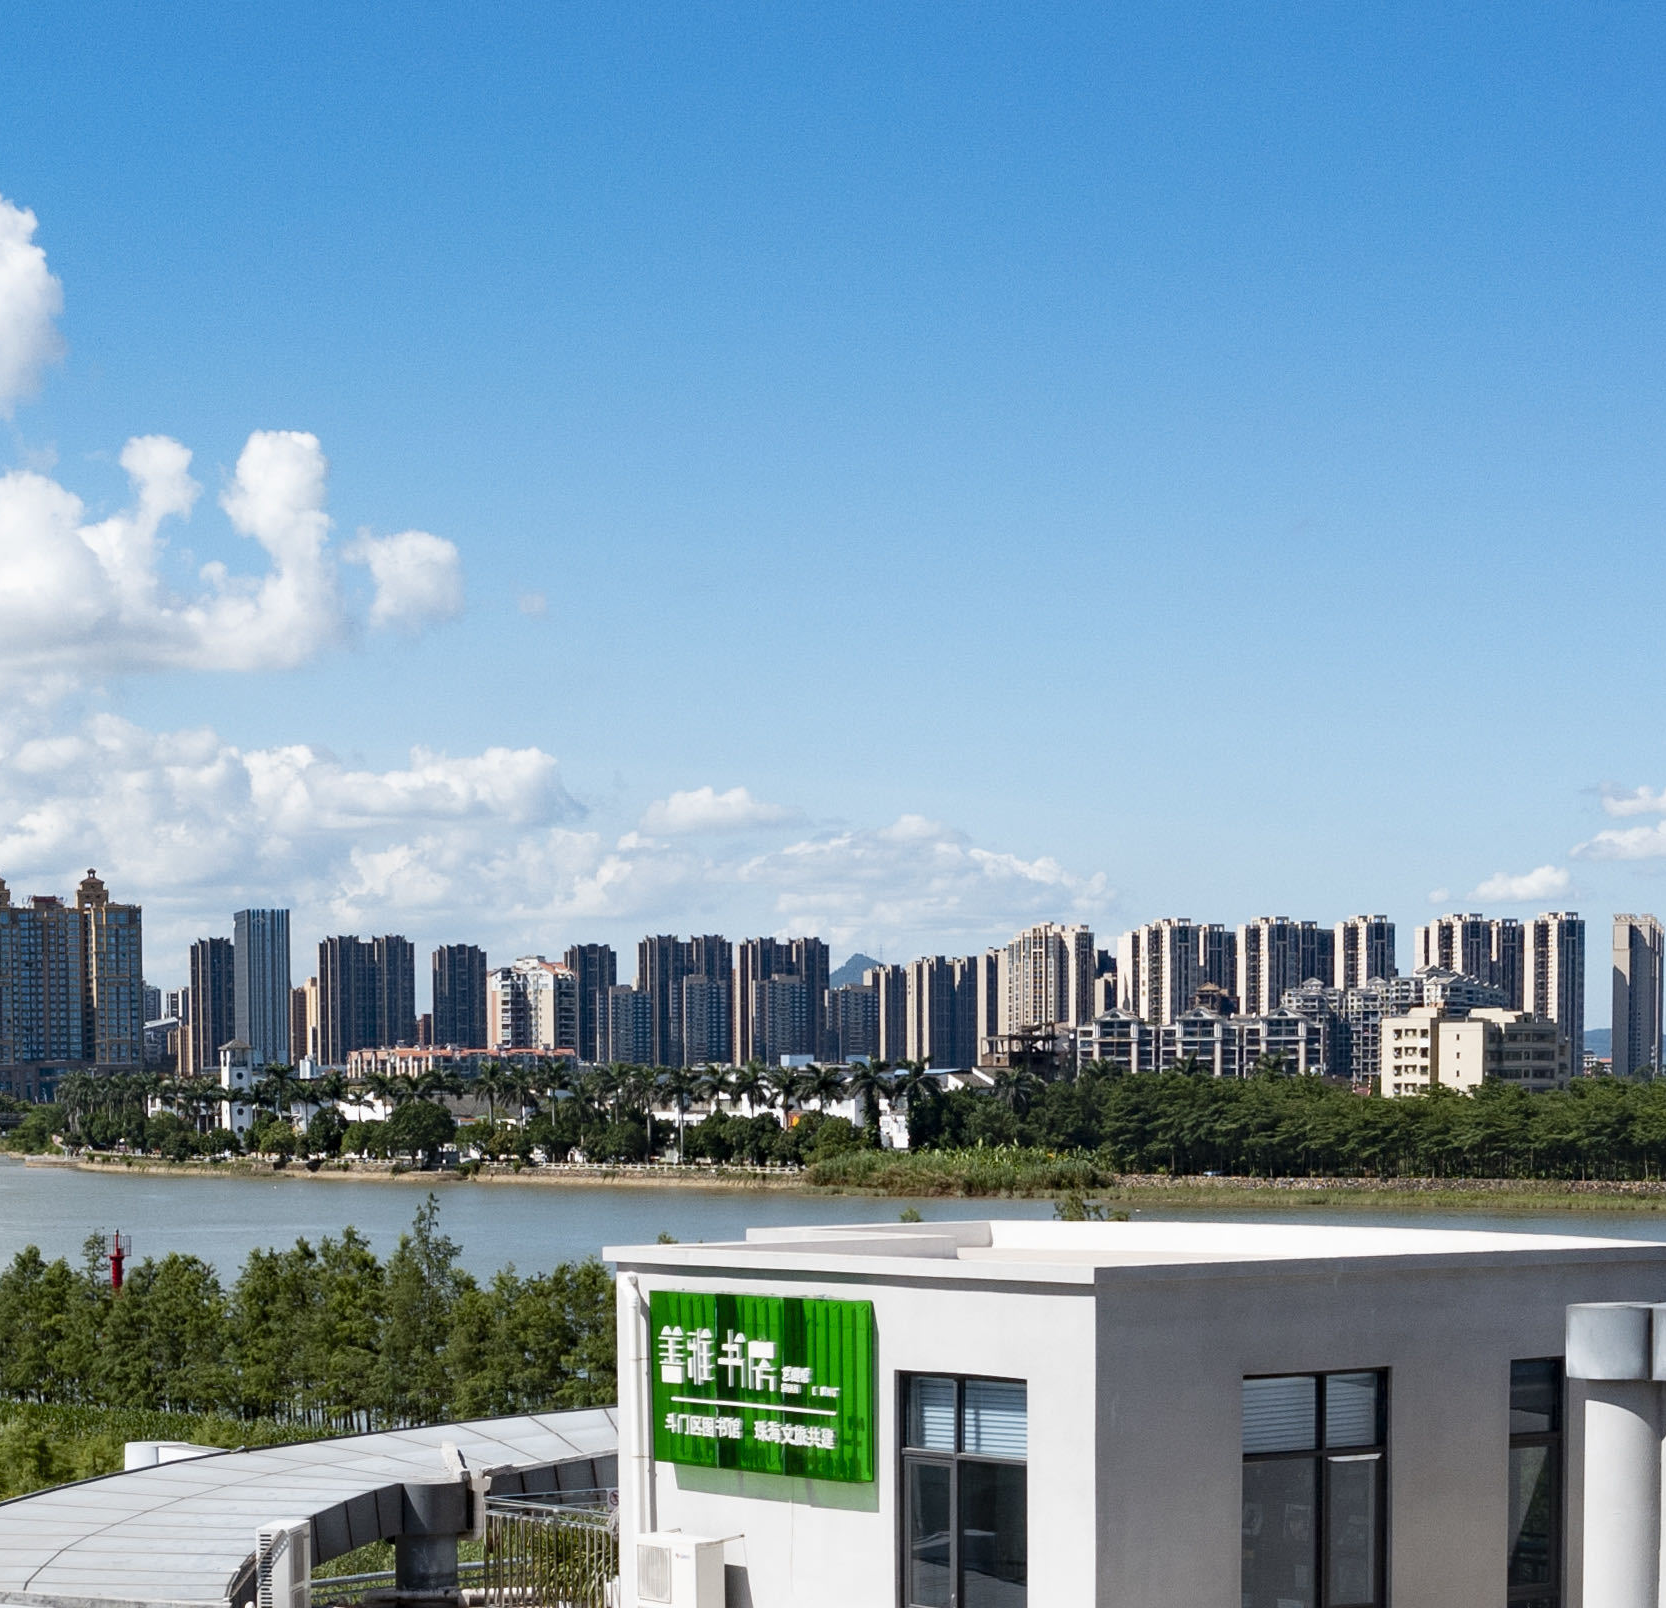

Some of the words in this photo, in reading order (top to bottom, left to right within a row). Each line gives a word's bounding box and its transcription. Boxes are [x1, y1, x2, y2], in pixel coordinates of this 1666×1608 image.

[658, 1325, 778, 1391] 善雅书房
[665, 1413, 743, 1439] 斗门区图书馆
